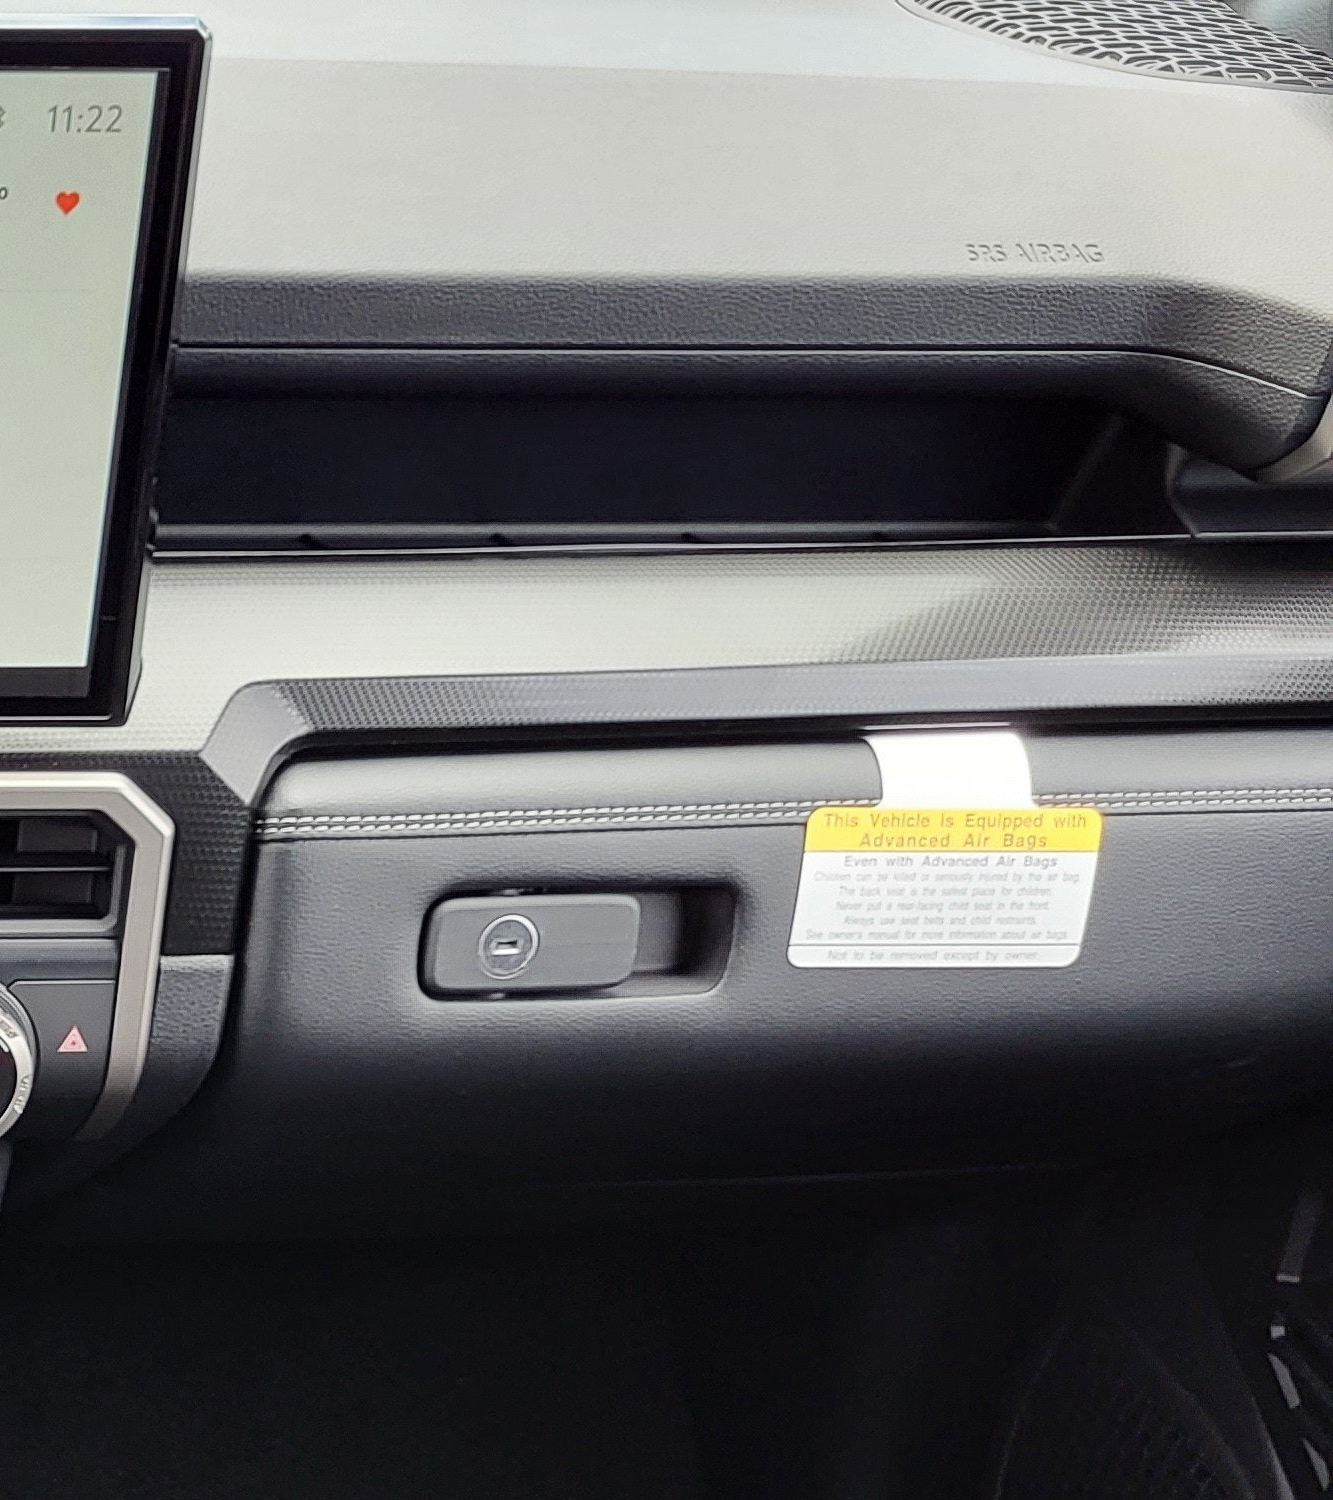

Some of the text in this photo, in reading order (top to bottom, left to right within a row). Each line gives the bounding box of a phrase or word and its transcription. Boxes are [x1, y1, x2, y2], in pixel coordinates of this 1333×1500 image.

[47, 104, 123, 133] 11:22
[965, 243, 1008, 263] SRS
[824, 812, 859, 829] This
[869, 812, 931, 829] Vehicle
[965, 813, 1044, 832] Equipped
[1053, 813, 1087, 829] with
[859, 832, 1048, 850] Advanced Air Bags
[844, 855, 1059, 870] Even with Advanced Air Bags
